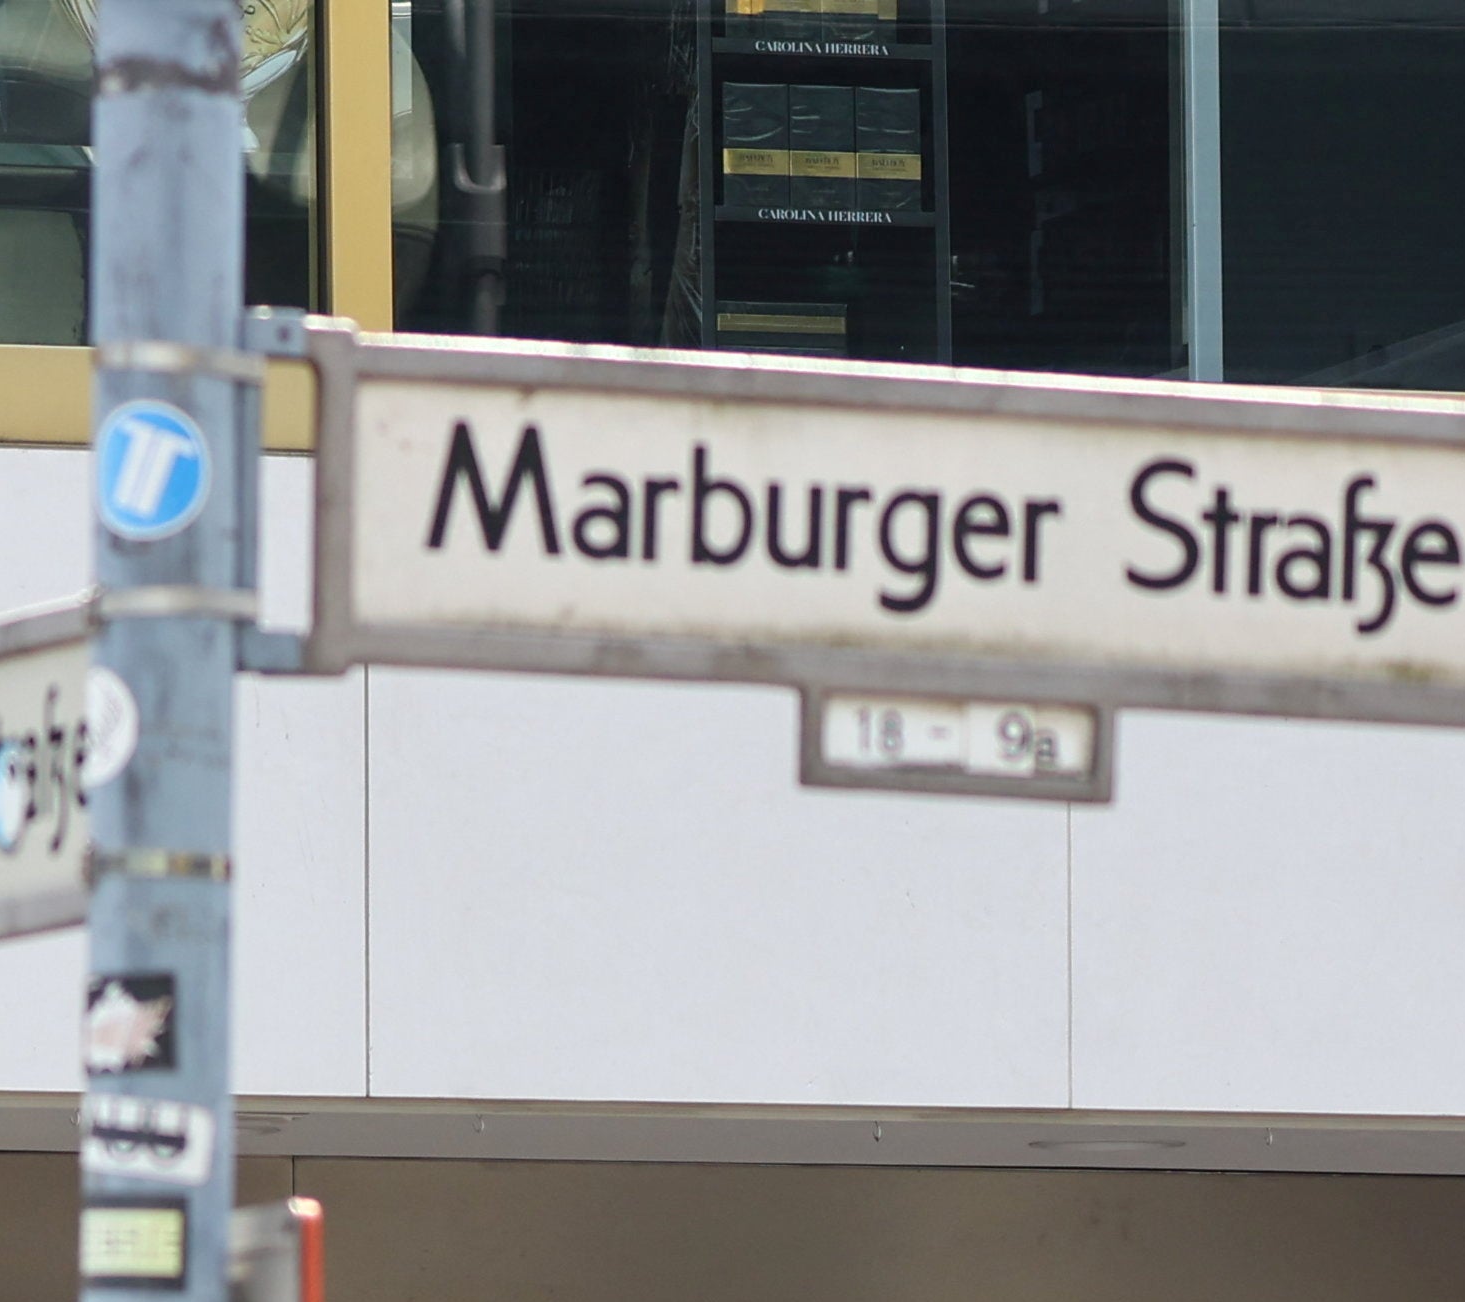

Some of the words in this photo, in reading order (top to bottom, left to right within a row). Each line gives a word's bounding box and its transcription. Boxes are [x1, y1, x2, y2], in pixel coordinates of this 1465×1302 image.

[755, 40, 821, 53] CAROLINA
[825, 43, 889, 56] HERRERA
[759, 208, 824, 221] CAROLINA
[828, 211, 892, 223] HERRERA
[424, 418, 1062, 615] Marburger
[1125, 458, 1462, 635] Straße
[996, 710, 1059, 764] 9a
